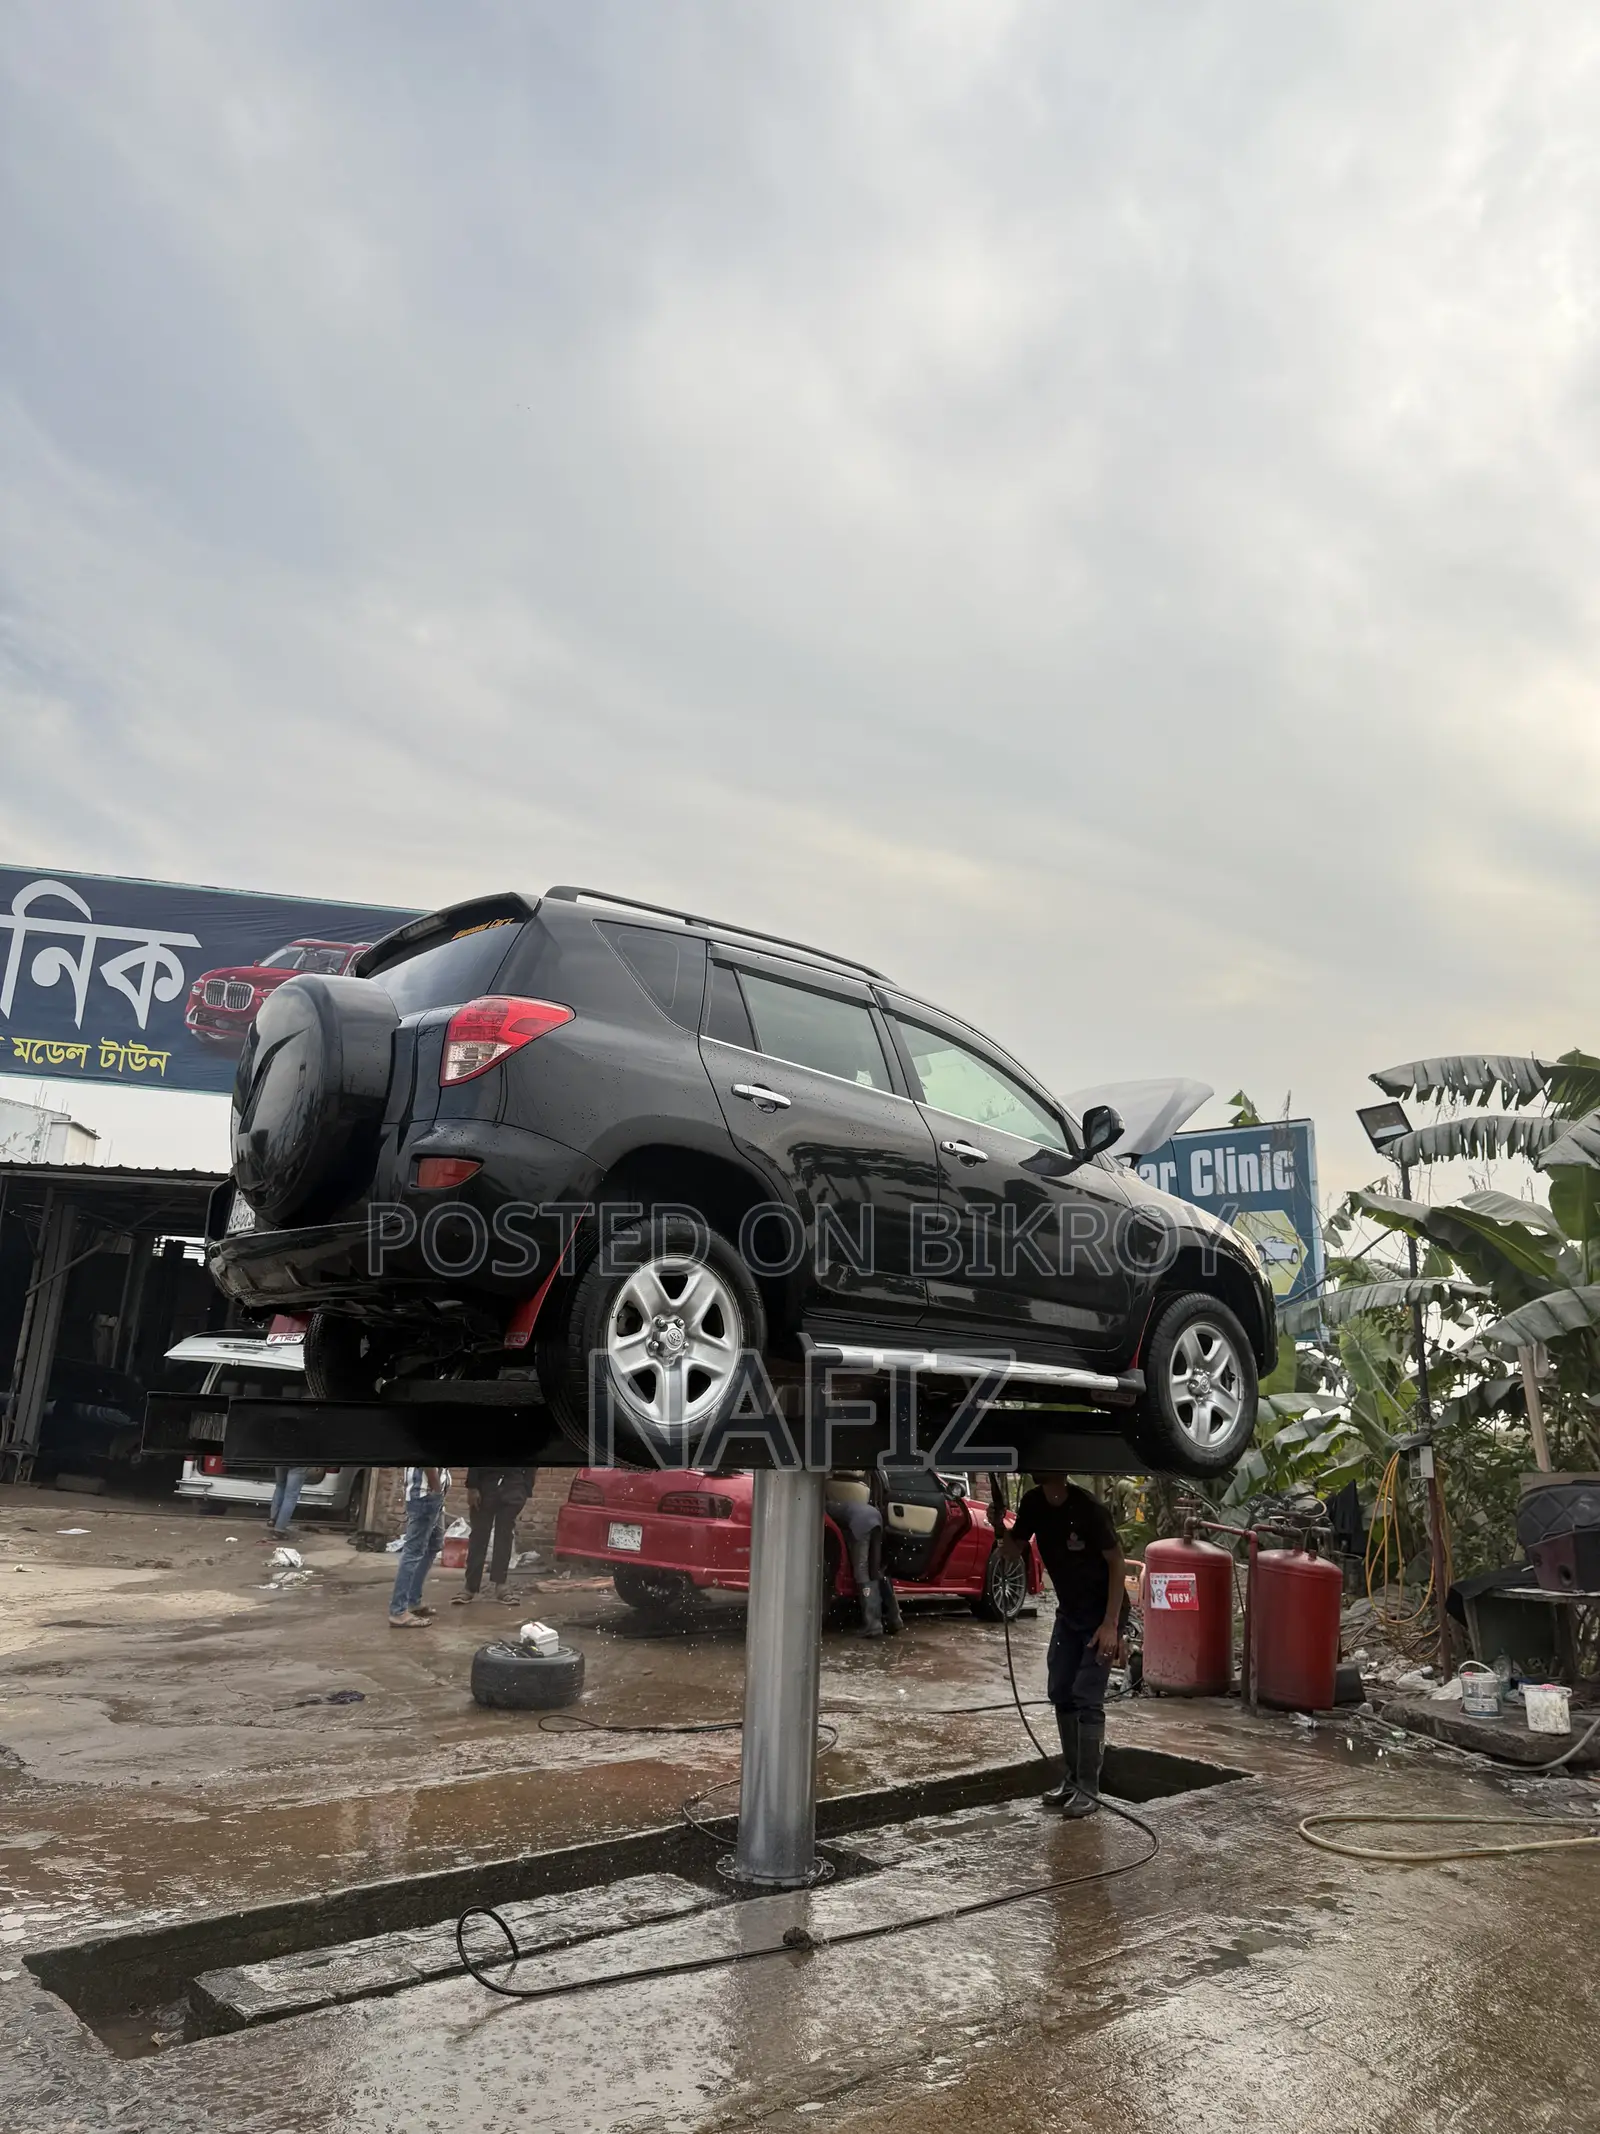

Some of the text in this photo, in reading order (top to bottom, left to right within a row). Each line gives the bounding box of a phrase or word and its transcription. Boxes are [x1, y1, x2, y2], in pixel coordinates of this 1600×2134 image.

[0, 879, 202, 1030] নিক
[11, 1036, 172, 1077] মডেল টাউন
[1135, 1143, 1295, 1197] ar Clinic
